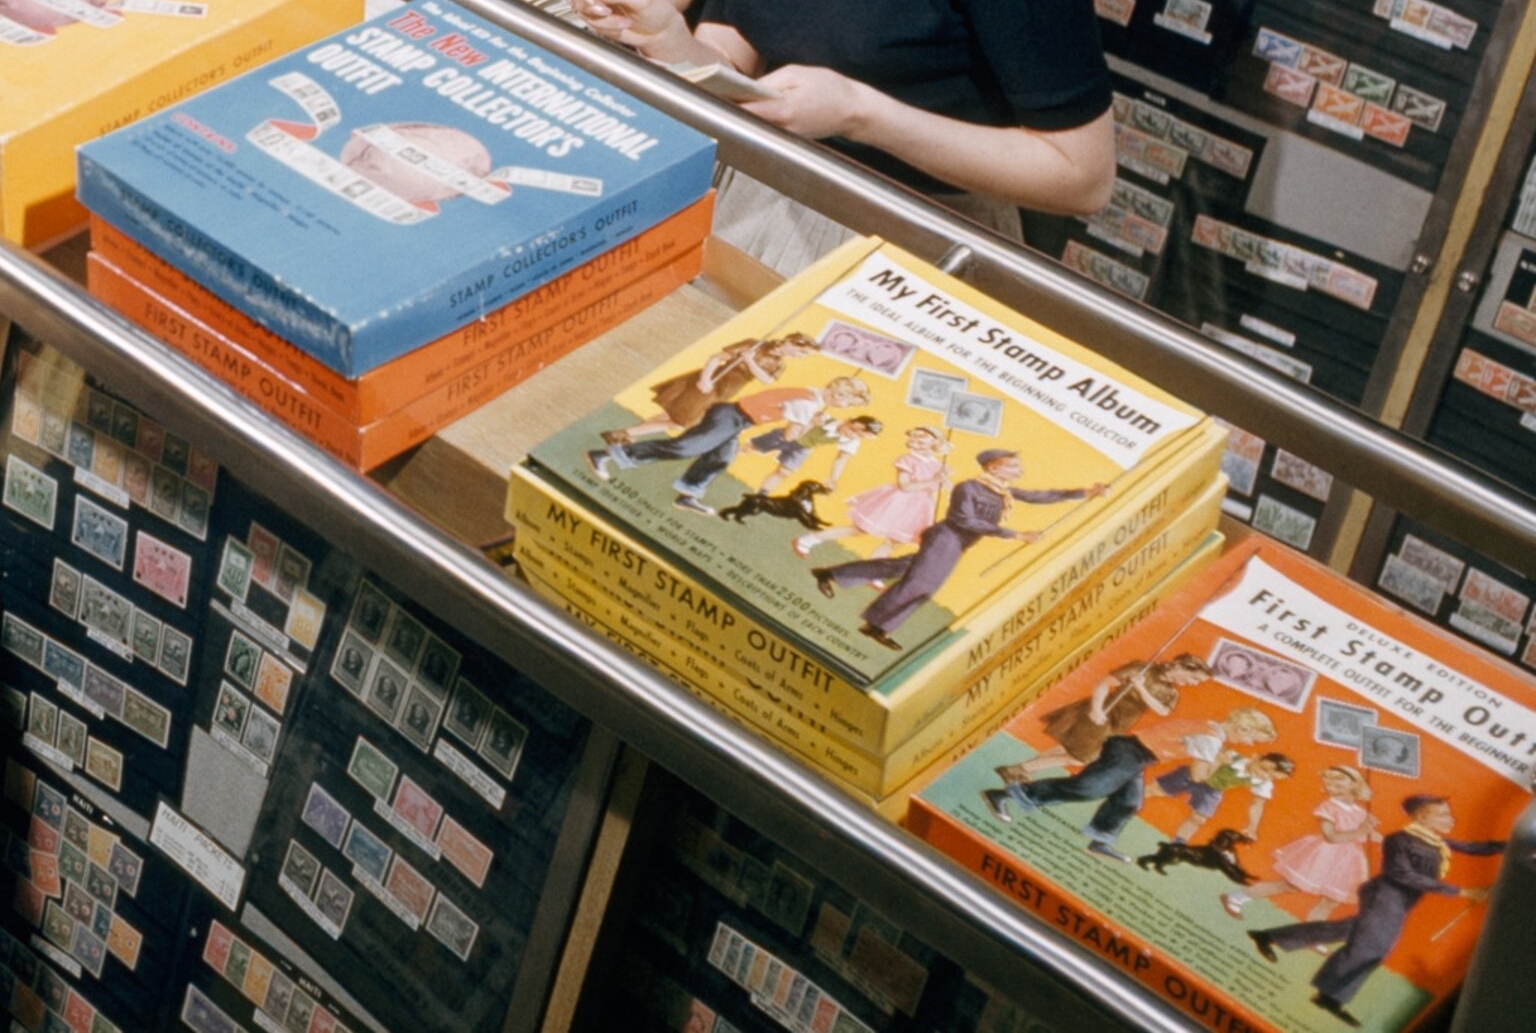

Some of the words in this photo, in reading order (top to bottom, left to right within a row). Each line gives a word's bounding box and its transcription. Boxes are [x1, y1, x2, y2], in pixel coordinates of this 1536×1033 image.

[100, 108, 142, 135] STAMP
[148, 64, 226, 113] COLLECTOR'S
[232, 40, 274, 69] OUTFIT
[306, 43, 403, 95] OUTFIT
[346, 25, 437, 73] STAMP
[422, 67, 584, 158] COLLECTOR'S
[386, 10, 435, 40] The
[430, 32, 489, 68] New
[477, 58, 659, 161] INTERNATIONAL
[421, 1, 440, 16] The
[508, 43, 529, 59] the
[526, 54, 585, 93] Beginning
[584, 87, 637, 118] Collector
[449, 274, 494, 309] STAMP
[503, 226, 586, 279] COLLECTOR'S
[595, 199, 639, 232] OUTFIT
[464, 308, 506, 345] FIRST
[514, 273, 573, 321] STAMP
[581, 236, 640, 282] OUTFIT
[144, 303, 188, 338] FIRST
[192, 334, 252, 381] STAMP
[259, 376, 323, 430] OUTFIT
[447, 364, 489, 402] FIRST
[497, 326, 556, 373] STAMP
[564, 291, 619, 333] OUTFIT
[845, 287, 868, 304] THE
[870, 300, 902, 324] IDEAL
[903, 320, 945, 347] ALBUM
[946, 342, 973, 360] FOR
[974, 355, 999, 374] THE
[996, 369, 1066, 413] BEGINNING
[1069, 409, 1137, 452] COLLECTOR
[868, 267, 919, 302] My
[915, 293, 979, 336] First
[977, 327, 1067, 383] Stamp
[1066, 376, 1163, 437] Album
[547, 503, 582, 534] MY
[590, 529, 648, 577] FIRST
[653, 570, 737, 631] STAMP
[747, 629, 836, 693] OUTFIT
[667, 514, 684, 529] FOR
[776, 583, 810, 611] 2500
[964, 675, 991, 708] MY
[999, 636, 1042, 680] FIRST
[1047, 583, 1105, 643] STAMP
[1112, 531, 1170, 587] OUTFIT
[966, 636, 994, 668] MY
[1000, 595, 1044, 642] FIRST
[1049, 541, 1107, 602] STAMP
[1113, 487, 1171, 548] OUTFIT
[564, 540, 594, 568] Stamps
[618, 576, 661, 611] Magnifier
[734, 649, 762, 675] Coats
[779, 679, 804, 700] Arms
[828, 708, 864, 738] Hinges
[566, 578, 597, 607] Stamps
[618, 614, 662, 648] Magnifier
[732, 688, 759, 714] Coats
[762, 710, 773, 722] of
[776, 718, 801, 740] Arms
[825, 747, 860, 777] Hinges
[787, 609, 800, 620] OF
[824, 632, 869, 661] COUNTRY
[1248, 588, 1329, 641] First
[1339, 637, 1445, 705] Stamp
[1463, 705, 1536, 756] Outf
[1345, 621, 1414, 660] DELUXE
[1425, 662, 1504, 710] EDITION
[1272, 631, 1343, 670] COMPLETE
[1343, 667, 1393, 700] OUTFIT
[1394, 696, 1425, 717] FOR
[1429, 713, 1457, 736] THE
[1457, 732, 1530, 774] BEGINNER
[72, 793, 94, 815] HAITI
[194, 834, 235, 871] PACKETS
[980, 852, 1049, 909] FIRST
[1056, 903, 1152, 973] STAMP
[1164, 974, 1262, 1033] OUTF
